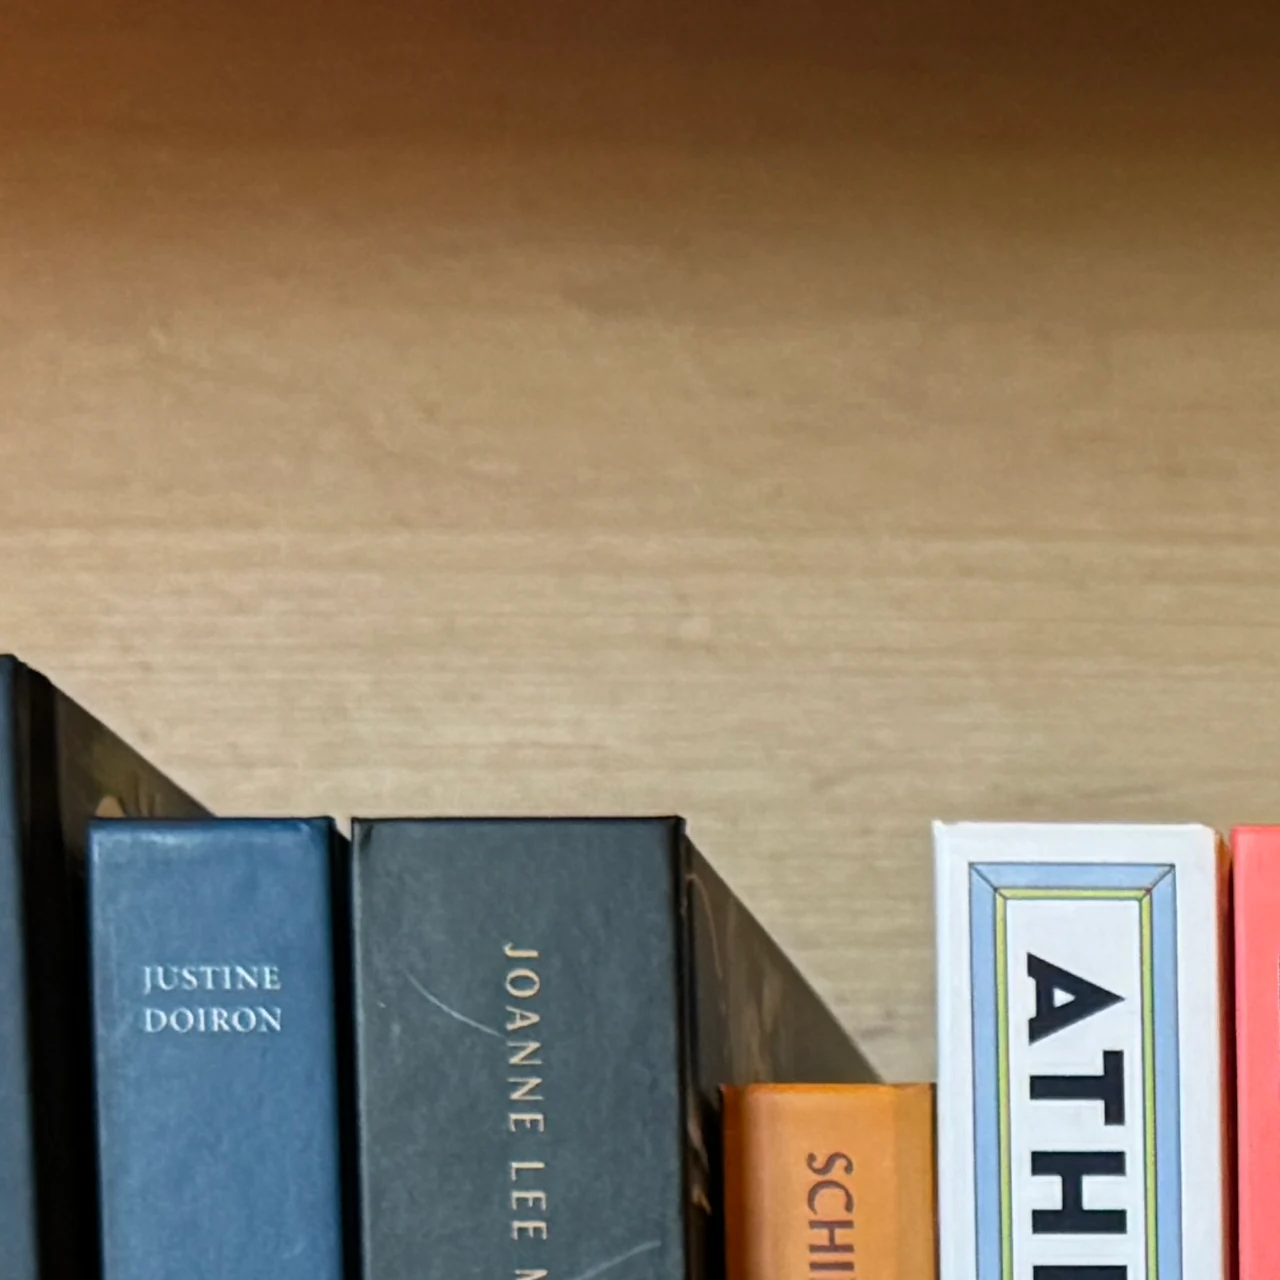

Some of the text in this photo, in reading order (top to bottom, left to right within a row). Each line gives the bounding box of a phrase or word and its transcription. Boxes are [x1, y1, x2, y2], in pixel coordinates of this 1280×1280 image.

[143, 965, 281, 994] JUSTINE
[143, 1007, 282, 1033] DOIRON
[503, 942, 545, 1133] JOANNE
[507, 1160, 547, 1242] LEE
